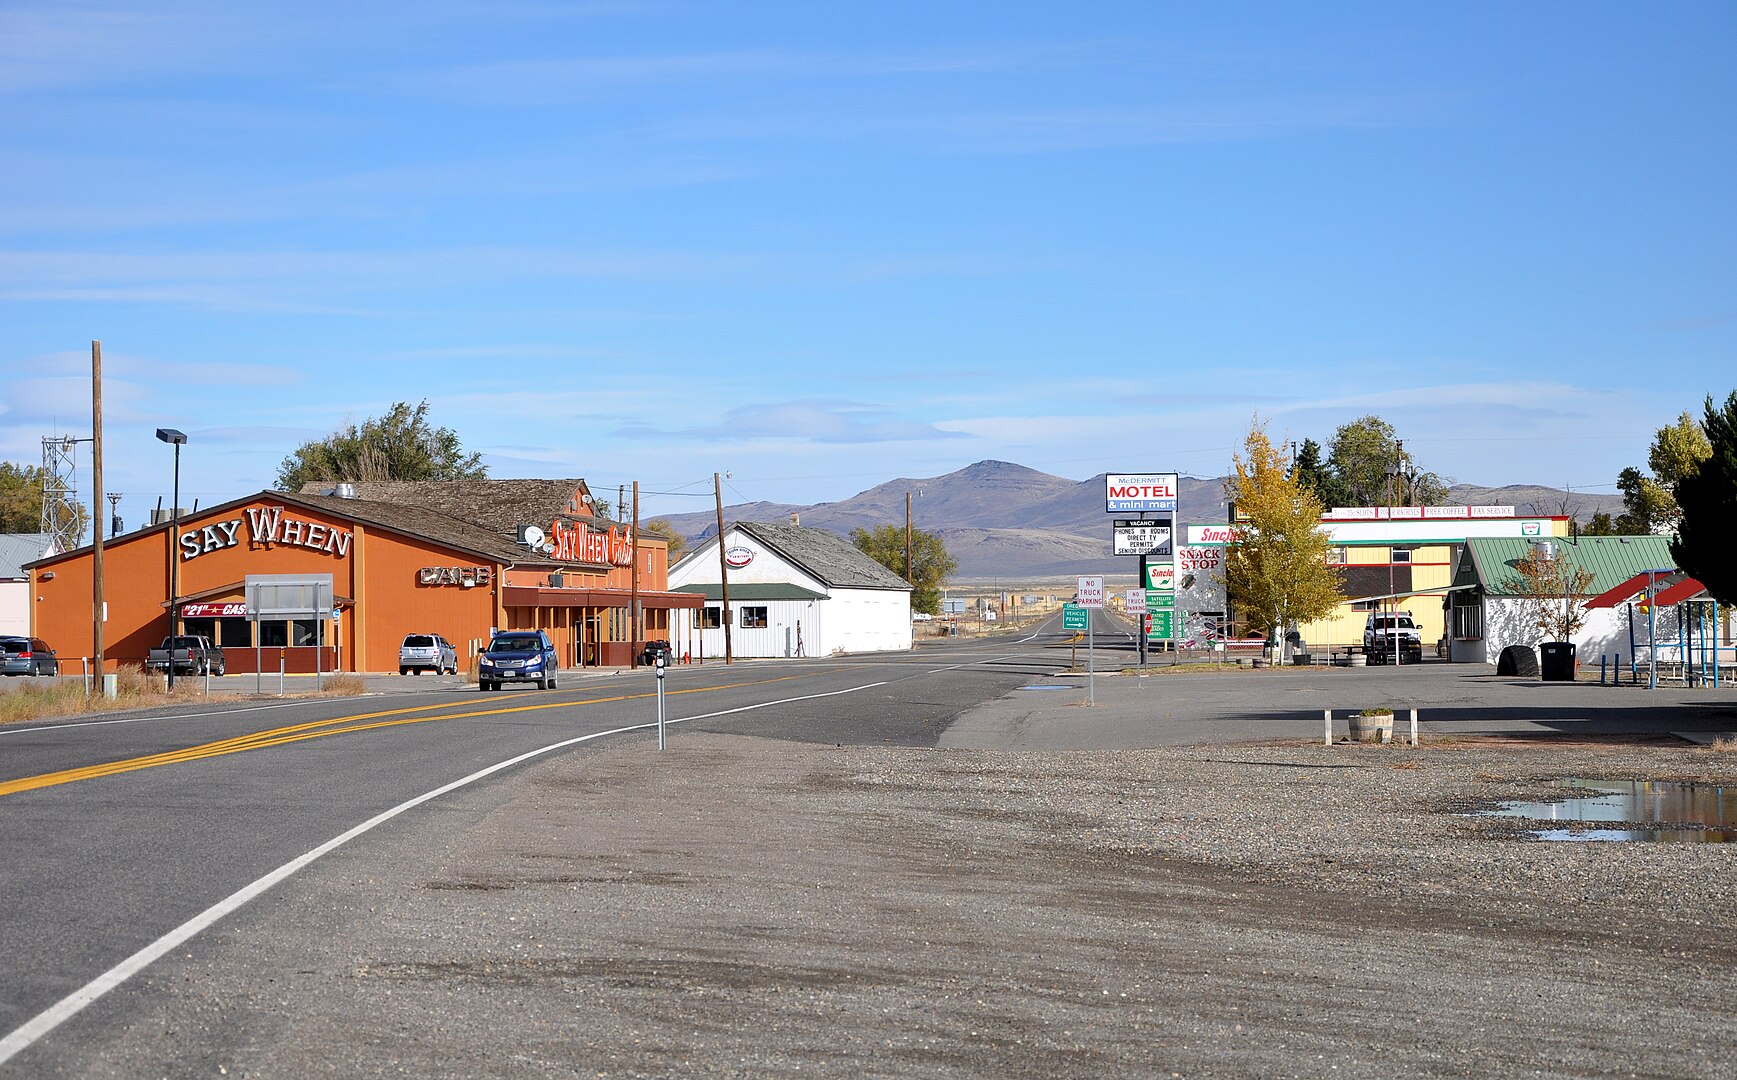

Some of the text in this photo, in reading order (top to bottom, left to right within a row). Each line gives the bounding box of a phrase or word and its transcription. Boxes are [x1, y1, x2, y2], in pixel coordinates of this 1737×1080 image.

[1109, 485, 1175, 498] MOTEL
[1108, 500, 1176, 509] & mini mart
[1426, 507, 1466, 516] FREE COFFEE
[1486, 507, 1512, 515] SERVICE
[180, 506, 354, 560] SAY WHEN
[1138, 547, 1168, 555] DISCOUNTS
[1179, 549, 1221, 560] SNACK
[1181, 559, 1219, 570] STOP
